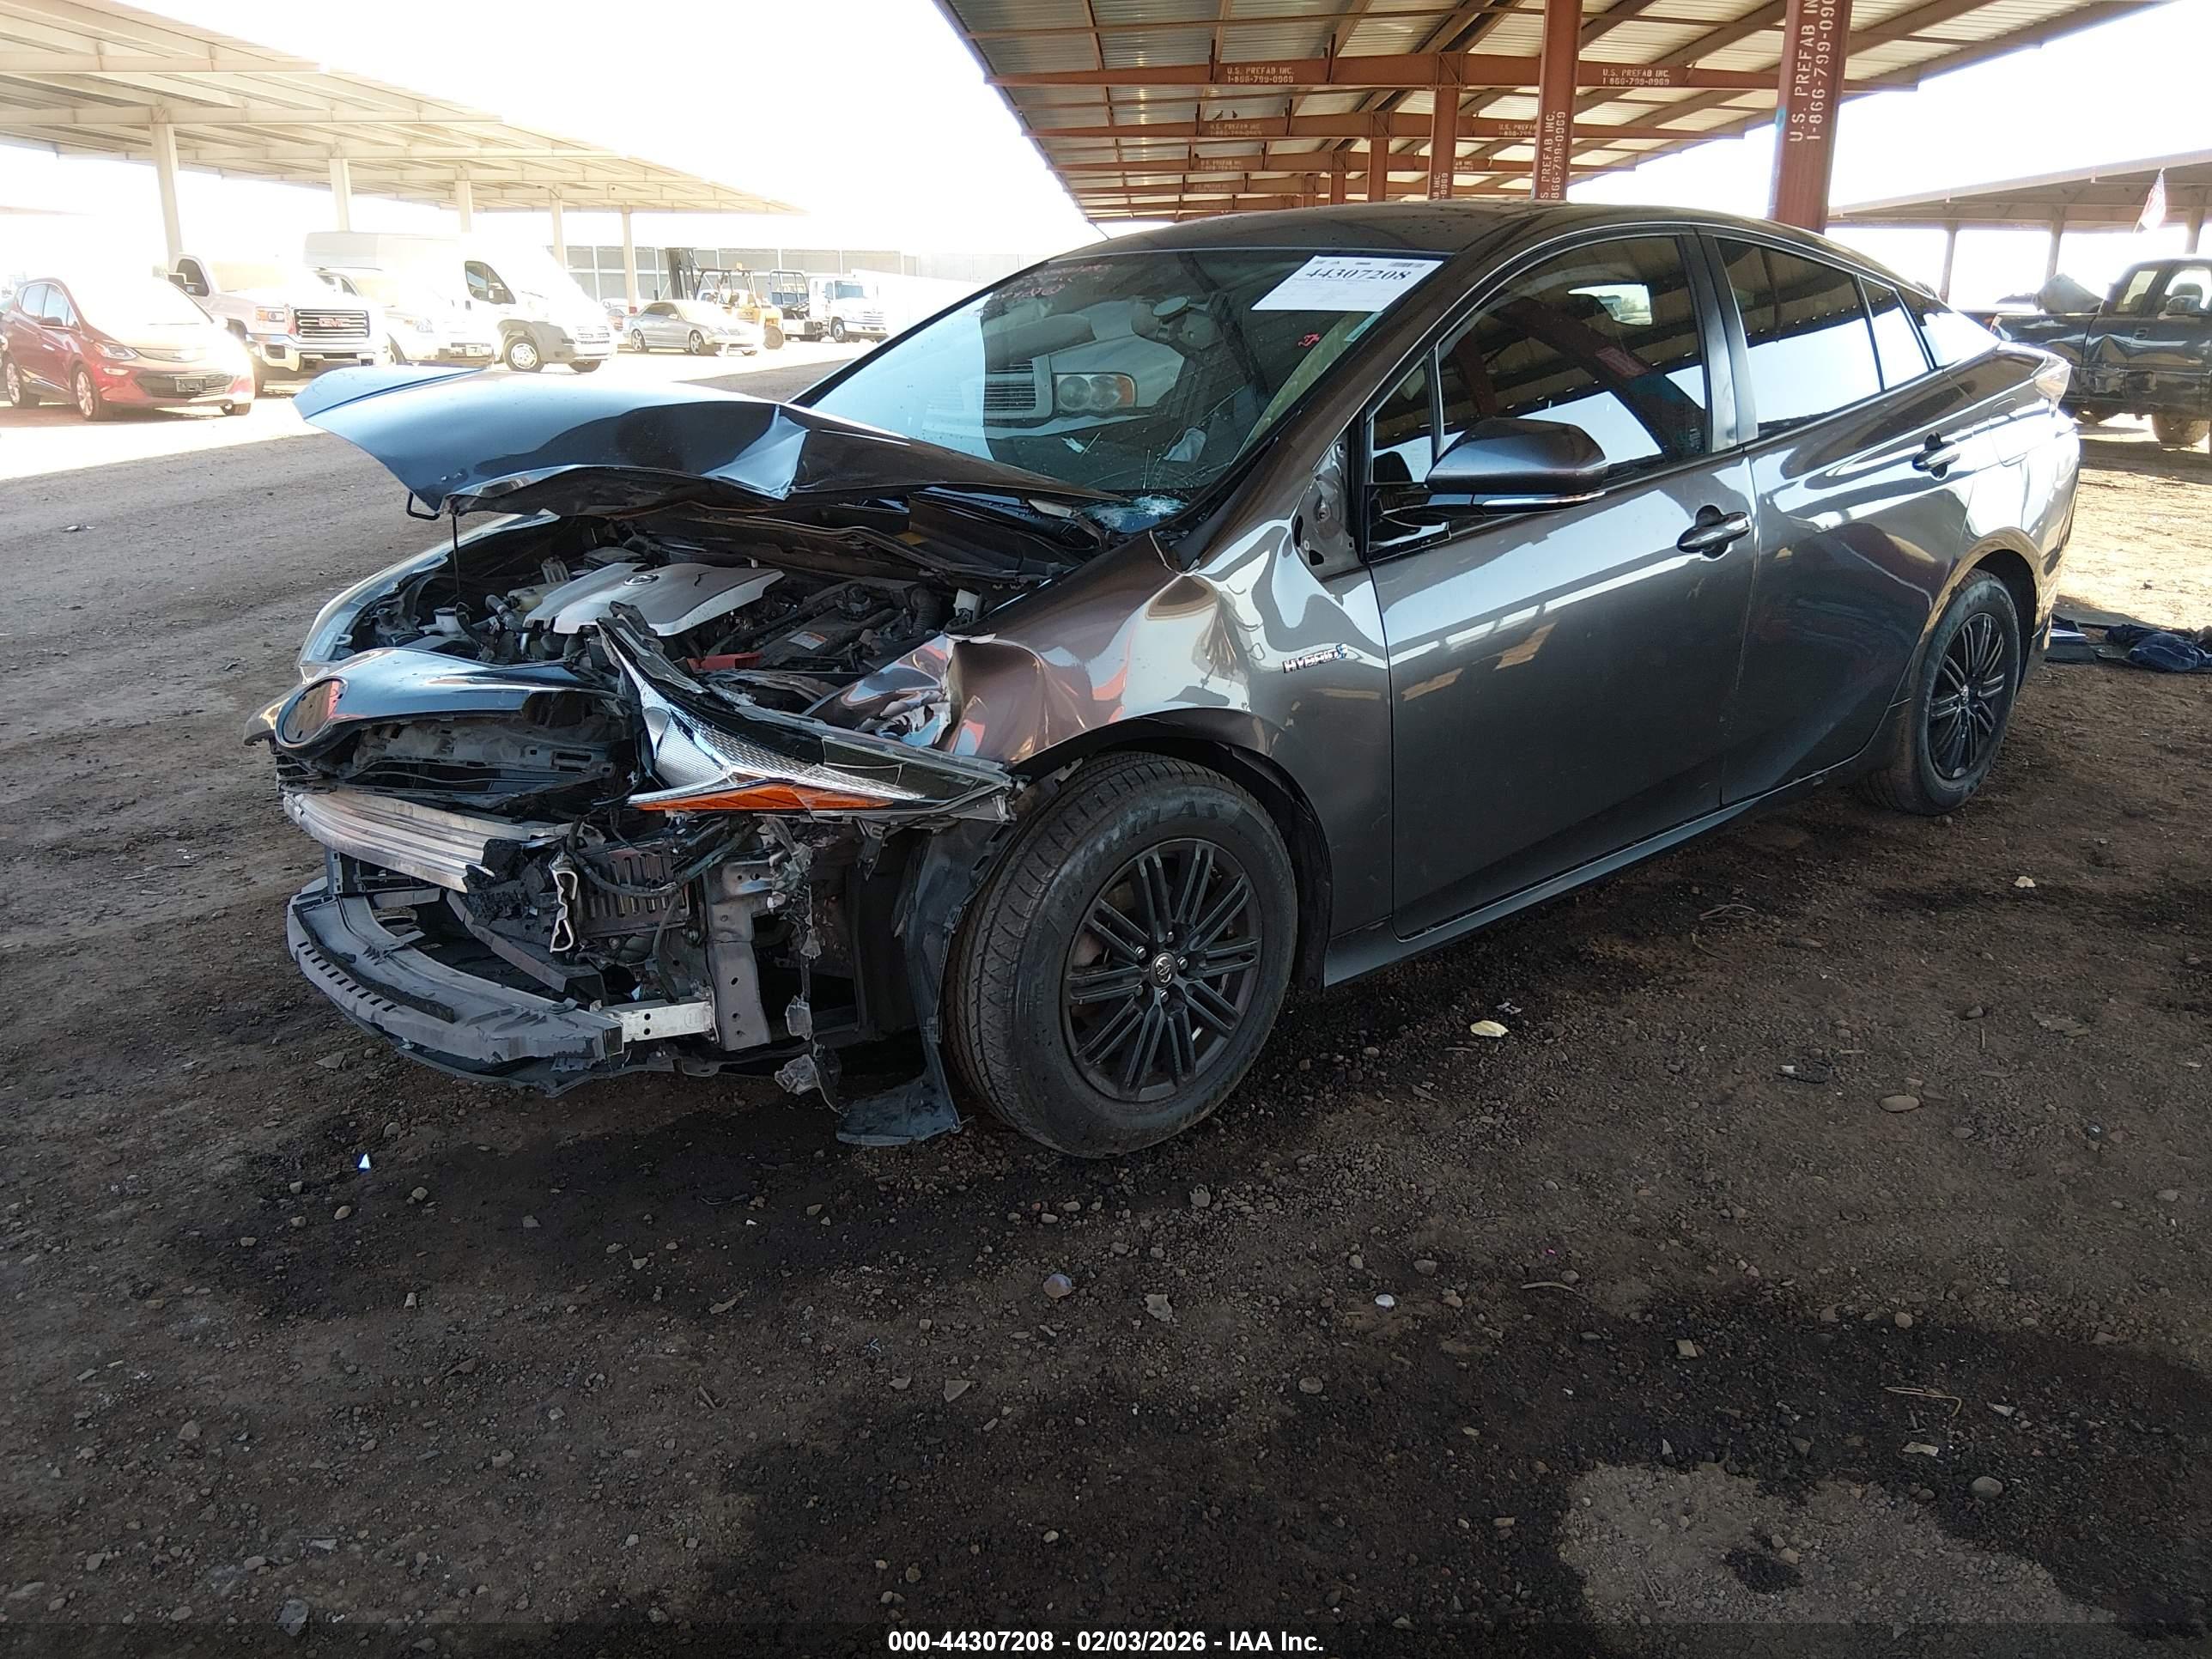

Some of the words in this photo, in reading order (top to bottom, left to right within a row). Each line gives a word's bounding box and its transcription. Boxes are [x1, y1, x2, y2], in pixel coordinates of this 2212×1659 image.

[1803, 0, 1819, 14] IN
[1227, 67, 1243, 76] U.S.
[1245, 67, 1276, 76] PREFAB
[1279, 66, 1295, 76] INC.
[1794, 24, 1816, 96] PREFAB
[1806, 0, 1836, 140] 1-866-799-09
[1602, 69, 1619, 77] U.S.
[1621, 69, 1653, 77] PREFAB
[1655, 70, 1670, 78] INC.
[1545, 111, 1556, 132] INC.
[1789, 106, 1807, 142] U.S.
[1540, 138, 1553, 183] PREFAB
[1551, 111, 1566, 199] 866-799-0969
[1306, 268, 1412, 281] 44307208
[1282, 648, 1339, 673] HYBRID
